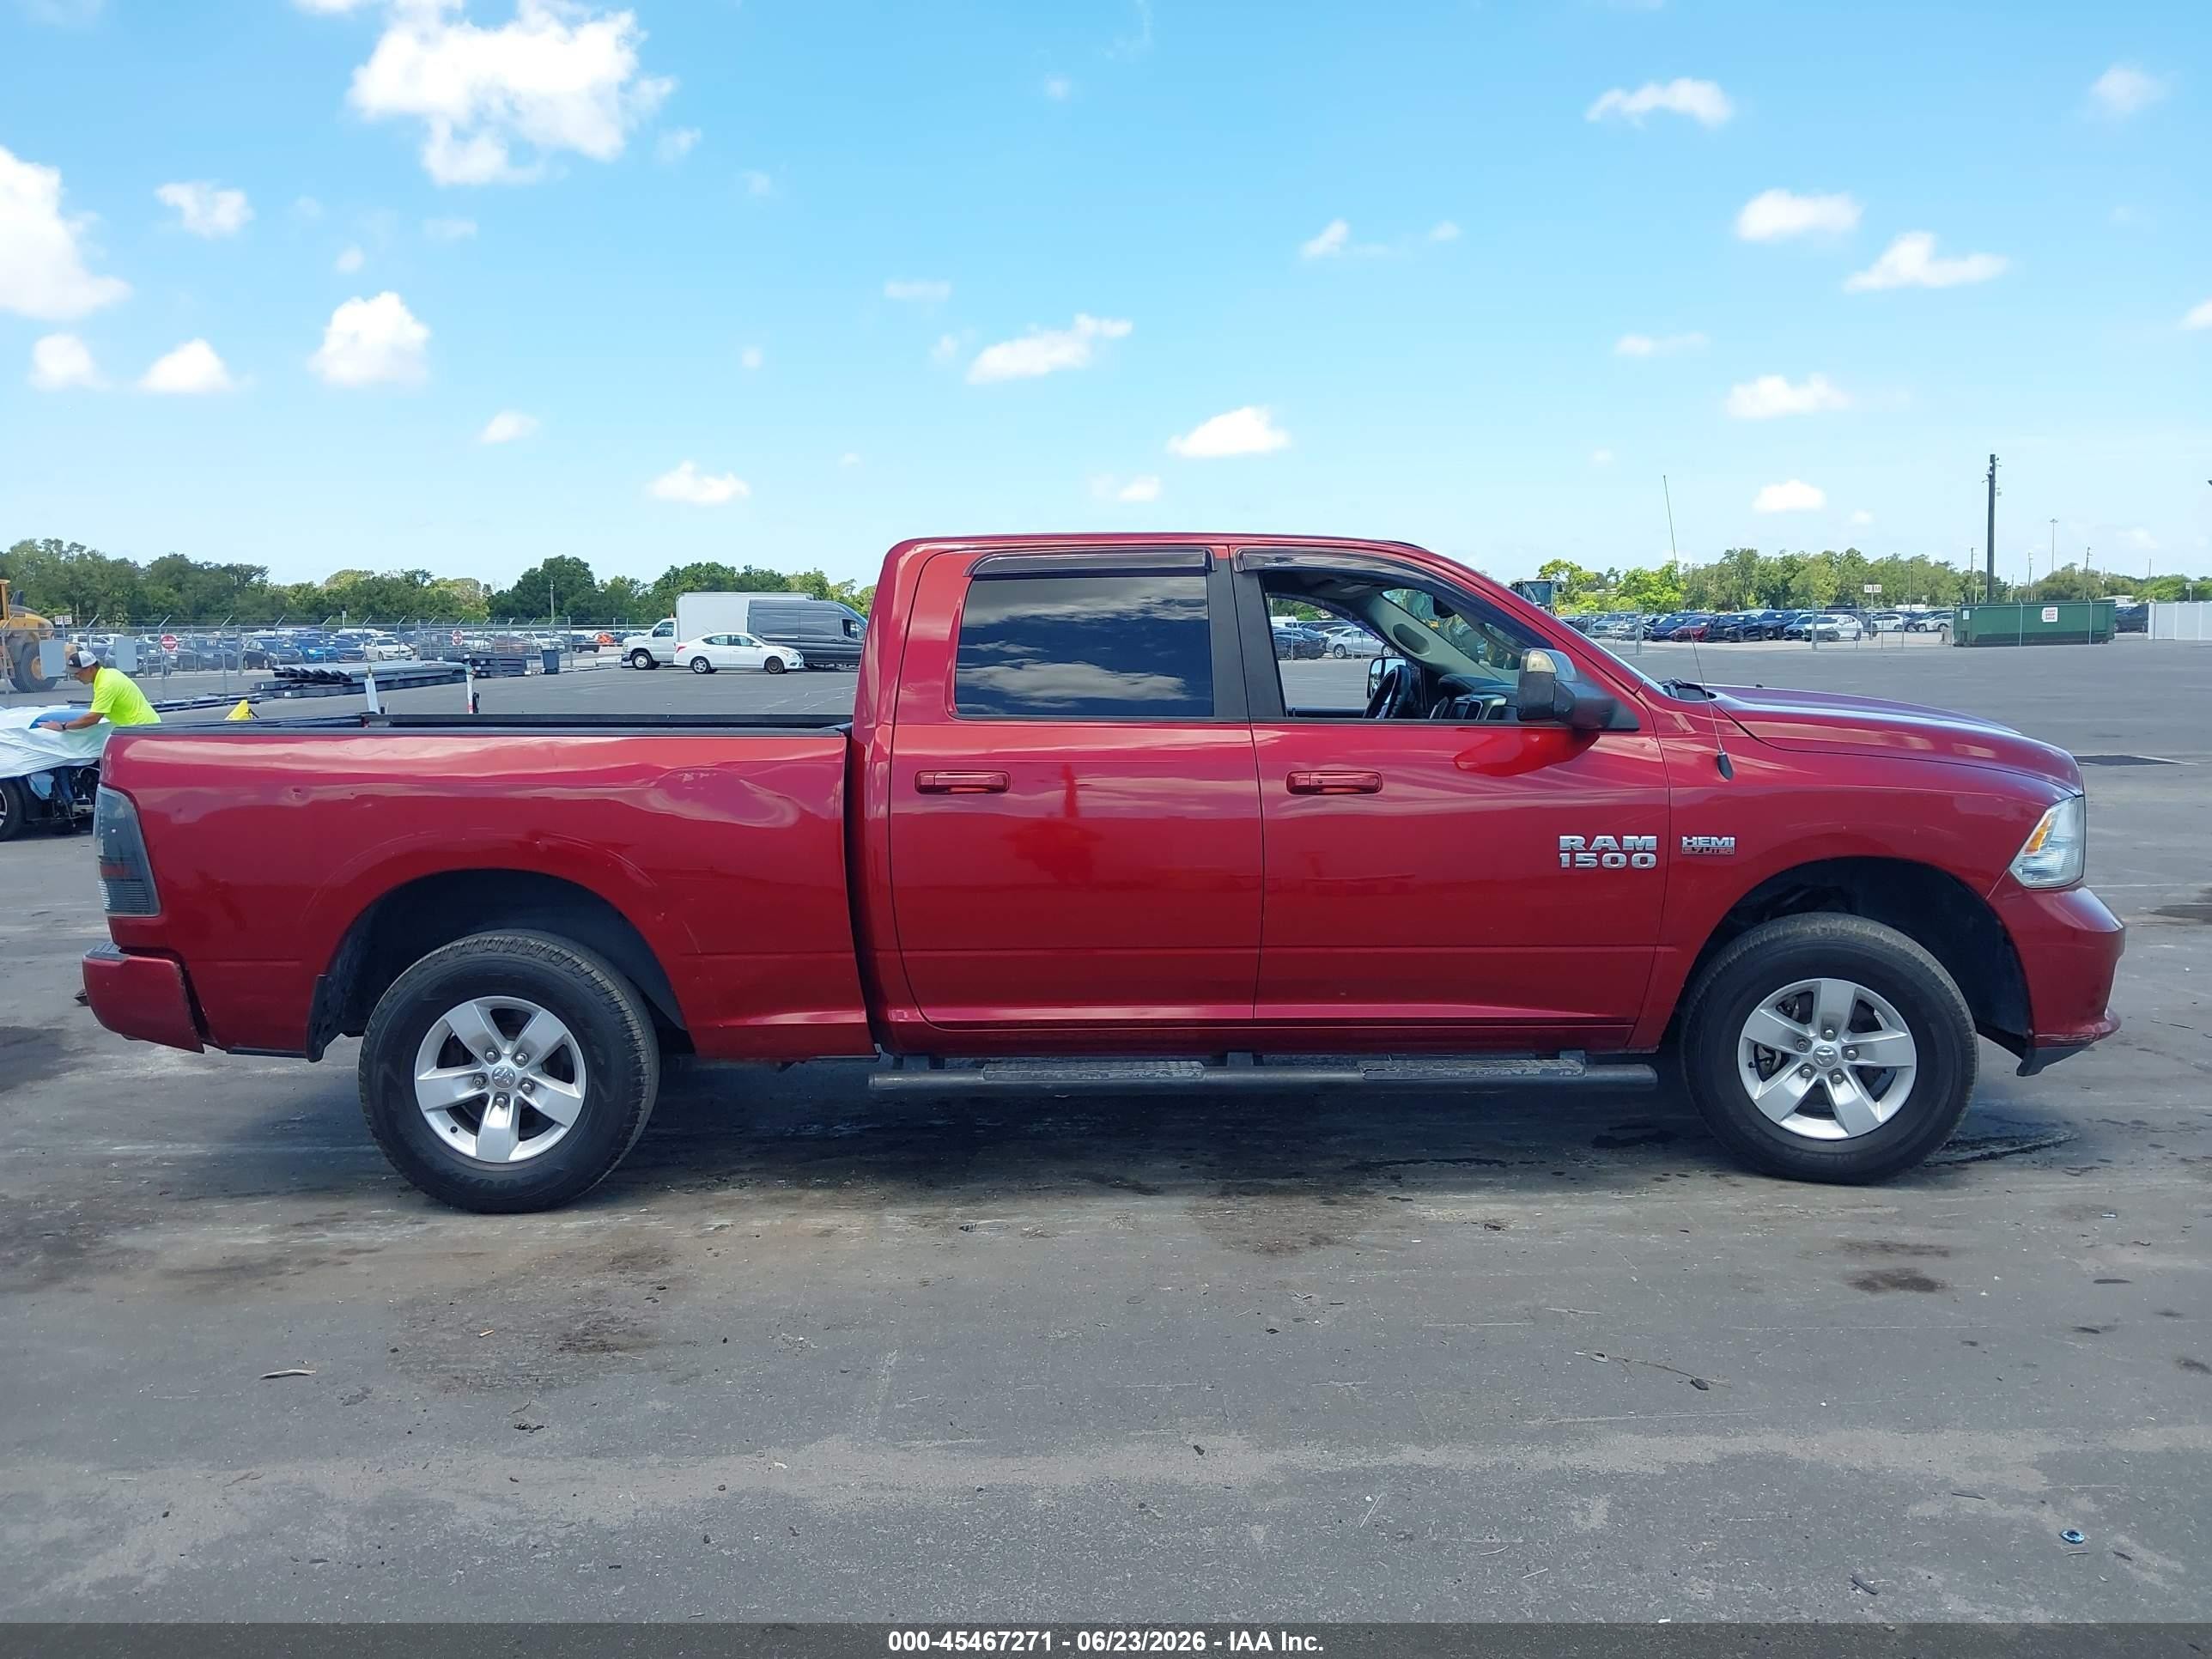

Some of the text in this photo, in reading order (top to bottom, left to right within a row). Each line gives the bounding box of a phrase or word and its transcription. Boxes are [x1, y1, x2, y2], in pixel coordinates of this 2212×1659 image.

[1559, 836, 1657, 851] RAM
[1682, 836, 1735, 847] HEMI
[1559, 853, 1657, 869] 1500
